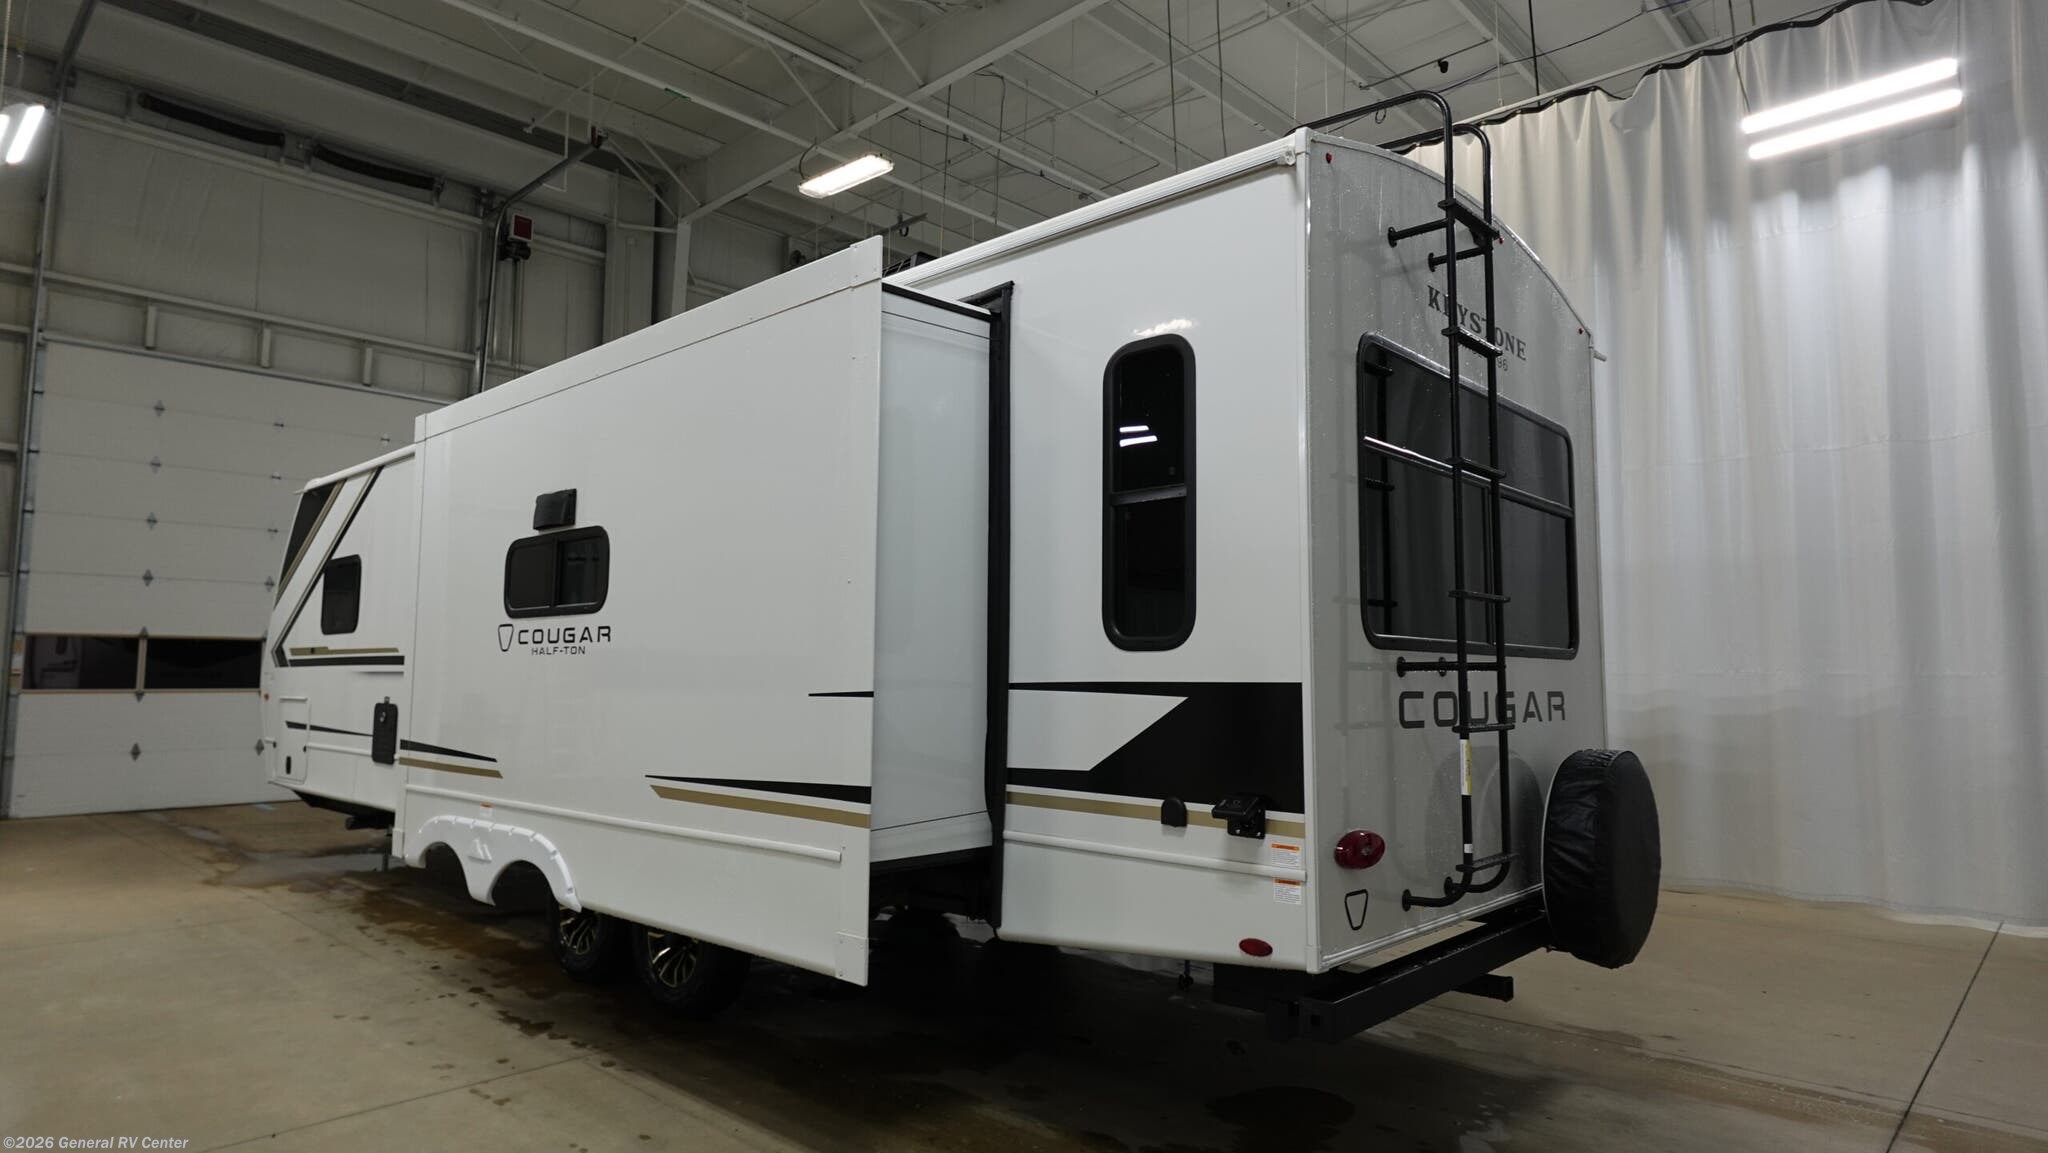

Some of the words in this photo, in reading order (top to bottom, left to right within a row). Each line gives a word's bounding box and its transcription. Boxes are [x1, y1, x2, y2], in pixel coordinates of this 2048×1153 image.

[1427, 285, 1527, 361] KYSONE
[518, 626, 611, 645] COUGAR
[531, 646, 586, 656] HALF-TON
[1399, 691, 1566, 729] COUGAR
